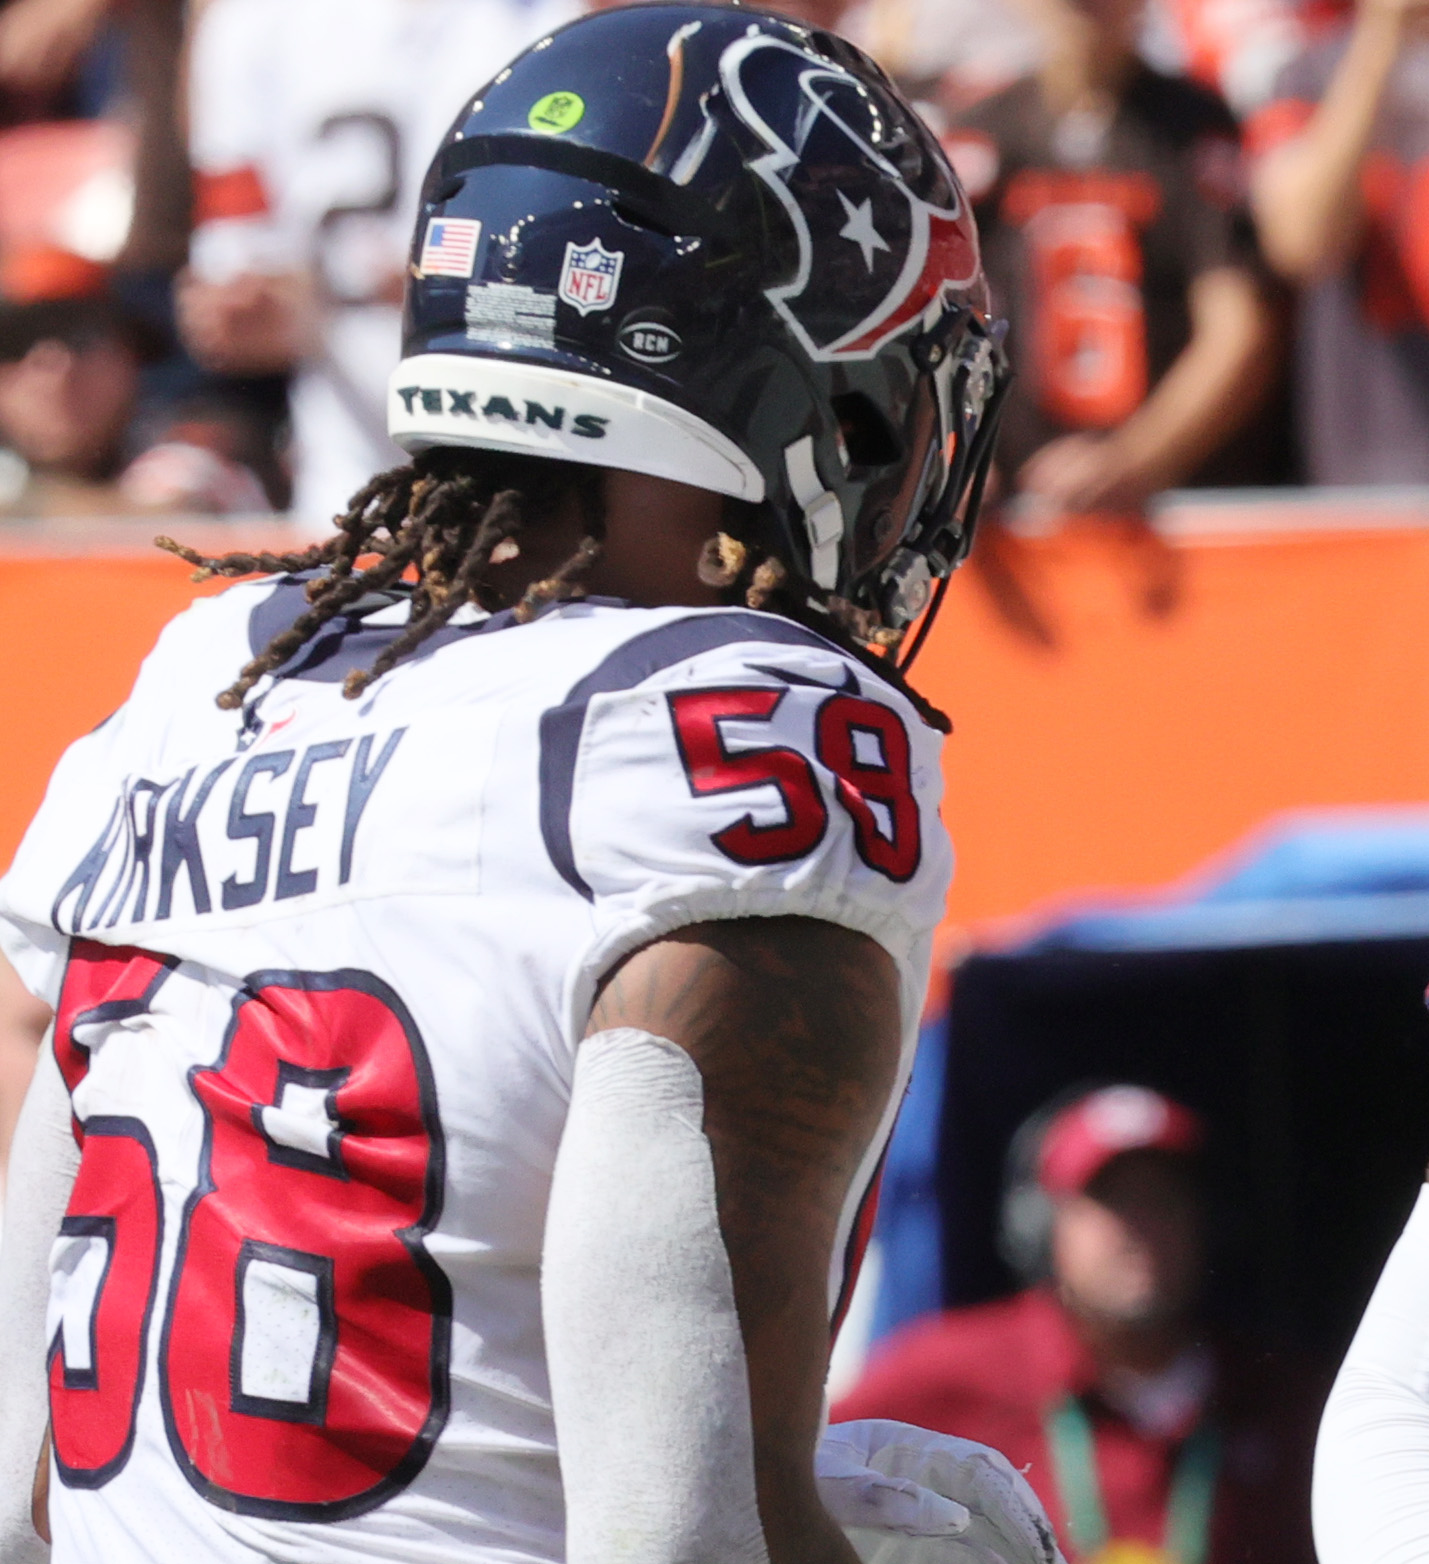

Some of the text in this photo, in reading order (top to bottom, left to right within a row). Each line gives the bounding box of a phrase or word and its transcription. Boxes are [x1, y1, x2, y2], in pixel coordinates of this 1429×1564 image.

[568, 271, 609, 302] NFL
[397, 384, 610, 438] TEXANS
[48, 936, 453, 1522] 58
